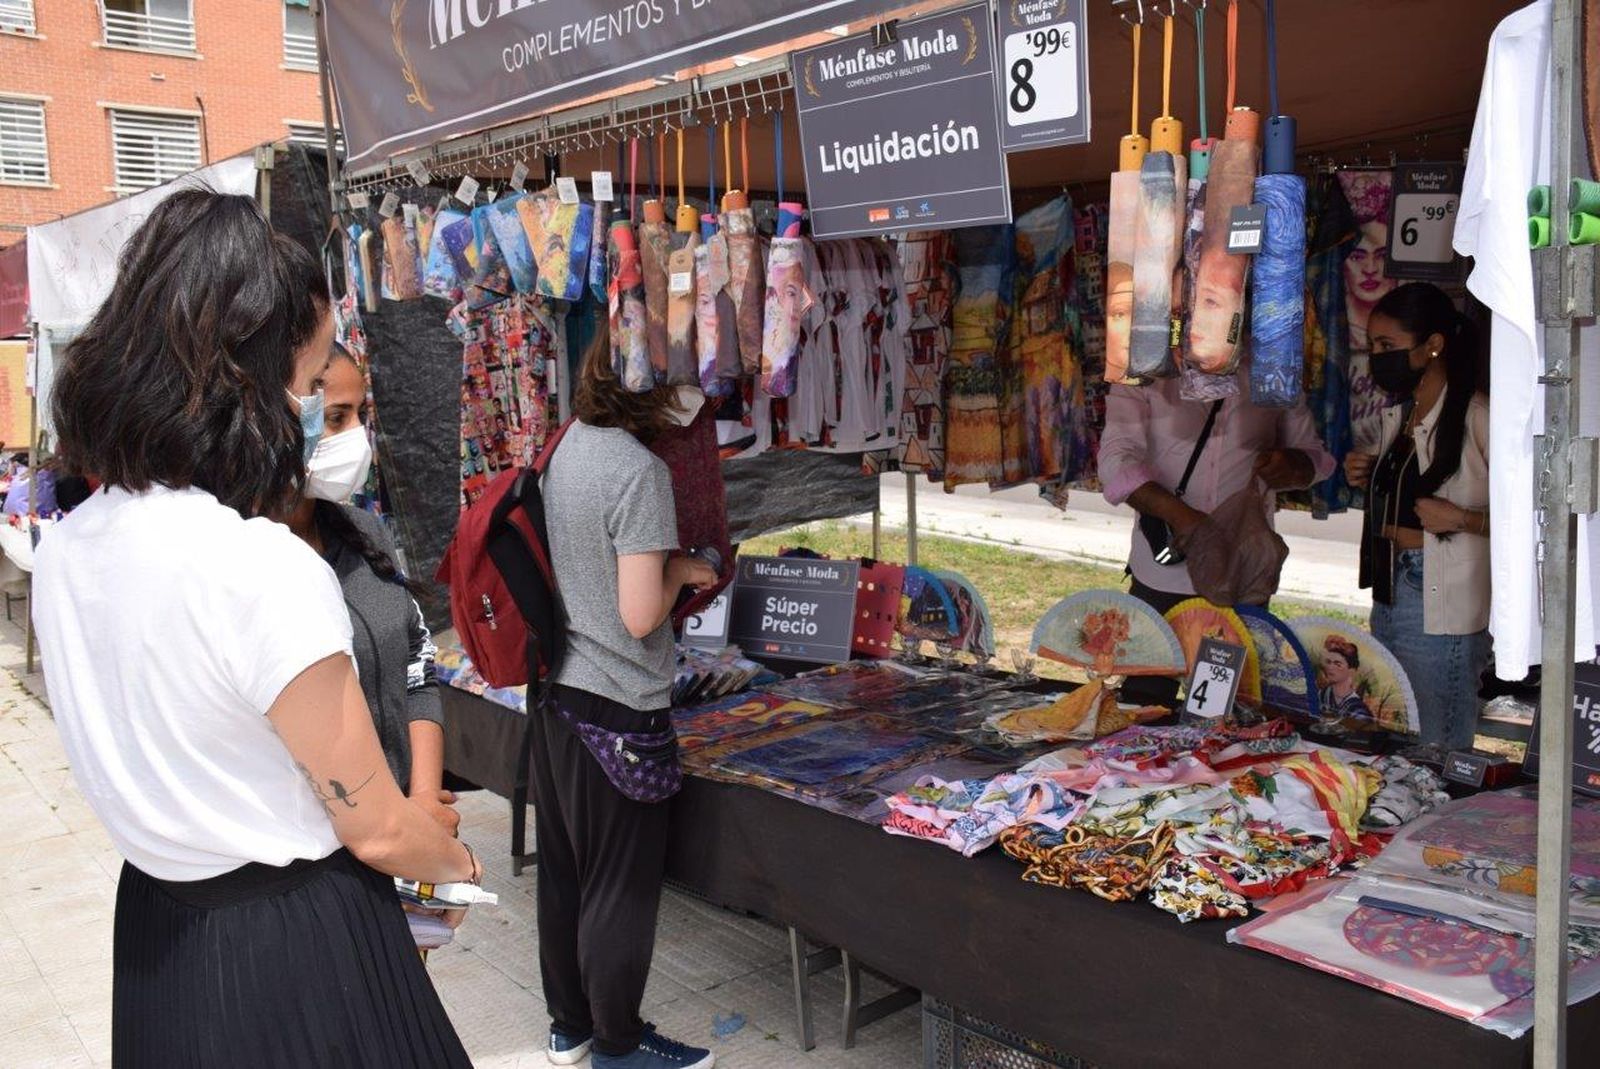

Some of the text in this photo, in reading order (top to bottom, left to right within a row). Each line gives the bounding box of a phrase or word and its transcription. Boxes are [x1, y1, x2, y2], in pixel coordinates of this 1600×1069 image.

[1018, 0, 1059, 15] Ménfase
[1026, 10, 1052, 25] Moda
[502, 0, 664, 73] COMPLEMENTOS
[819, 29, 959, 83] Ménfase Moda
[1009, 58, 1036, 113] 8
[819, 121, 980, 174] Liquidación
[1400, 217, 1419, 246] 6
[754, 562, 839, 580] Ménfase Moda
[765, 596, 819, 618] Súper
[761, 615, 818, 636] Precio
[1191, 680, 1209, 709] 4
